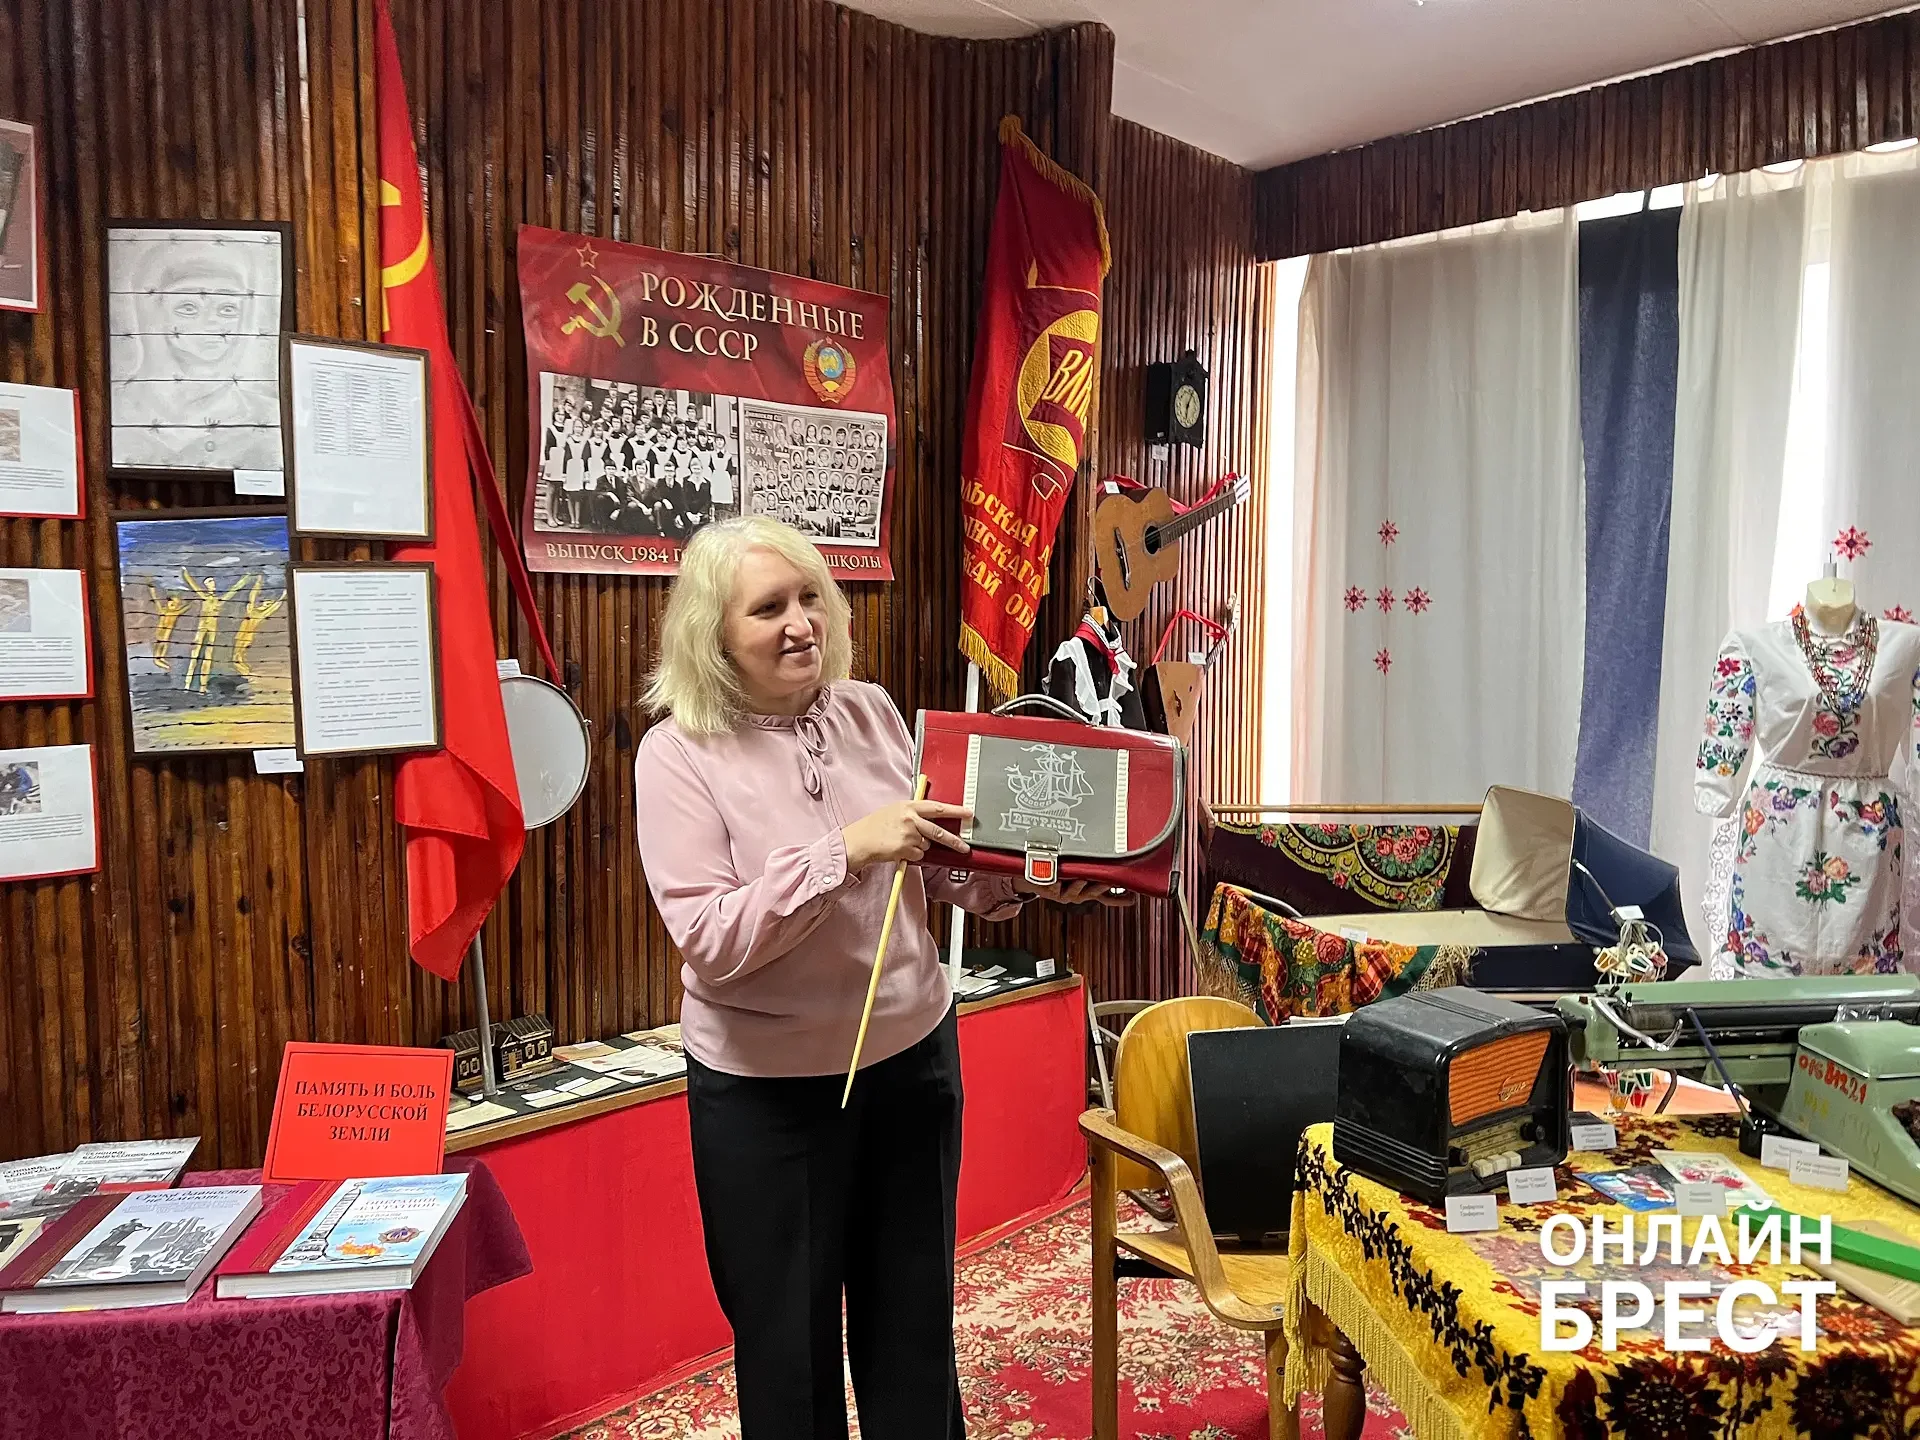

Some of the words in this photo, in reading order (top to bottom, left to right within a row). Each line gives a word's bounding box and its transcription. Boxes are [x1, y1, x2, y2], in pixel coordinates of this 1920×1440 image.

[639, 271, 865, 341] РОЖДЕННЫЕ
[639, 315, 660, 347] В
[668, 322, 759, 361] СССР
[960, 474, 1038, 548] ЛЬСКАЯ
[545, 543, 632, 564] ВЫПУСК
[631, 544, 669, 564] 1984
[824, 553, 883, 571] ШКОЛЫ
[294, 1080, 369, 1097] ПАМЯТЬ
[373, 1083, 386, 1097] И
[390, 1083, 436, 1100] БОЛЬ
[296, 1102, 429, 1121] БЕЛОРУССКОЙ
[328, 1125, 391, 1142] ЗЕМЛИ
